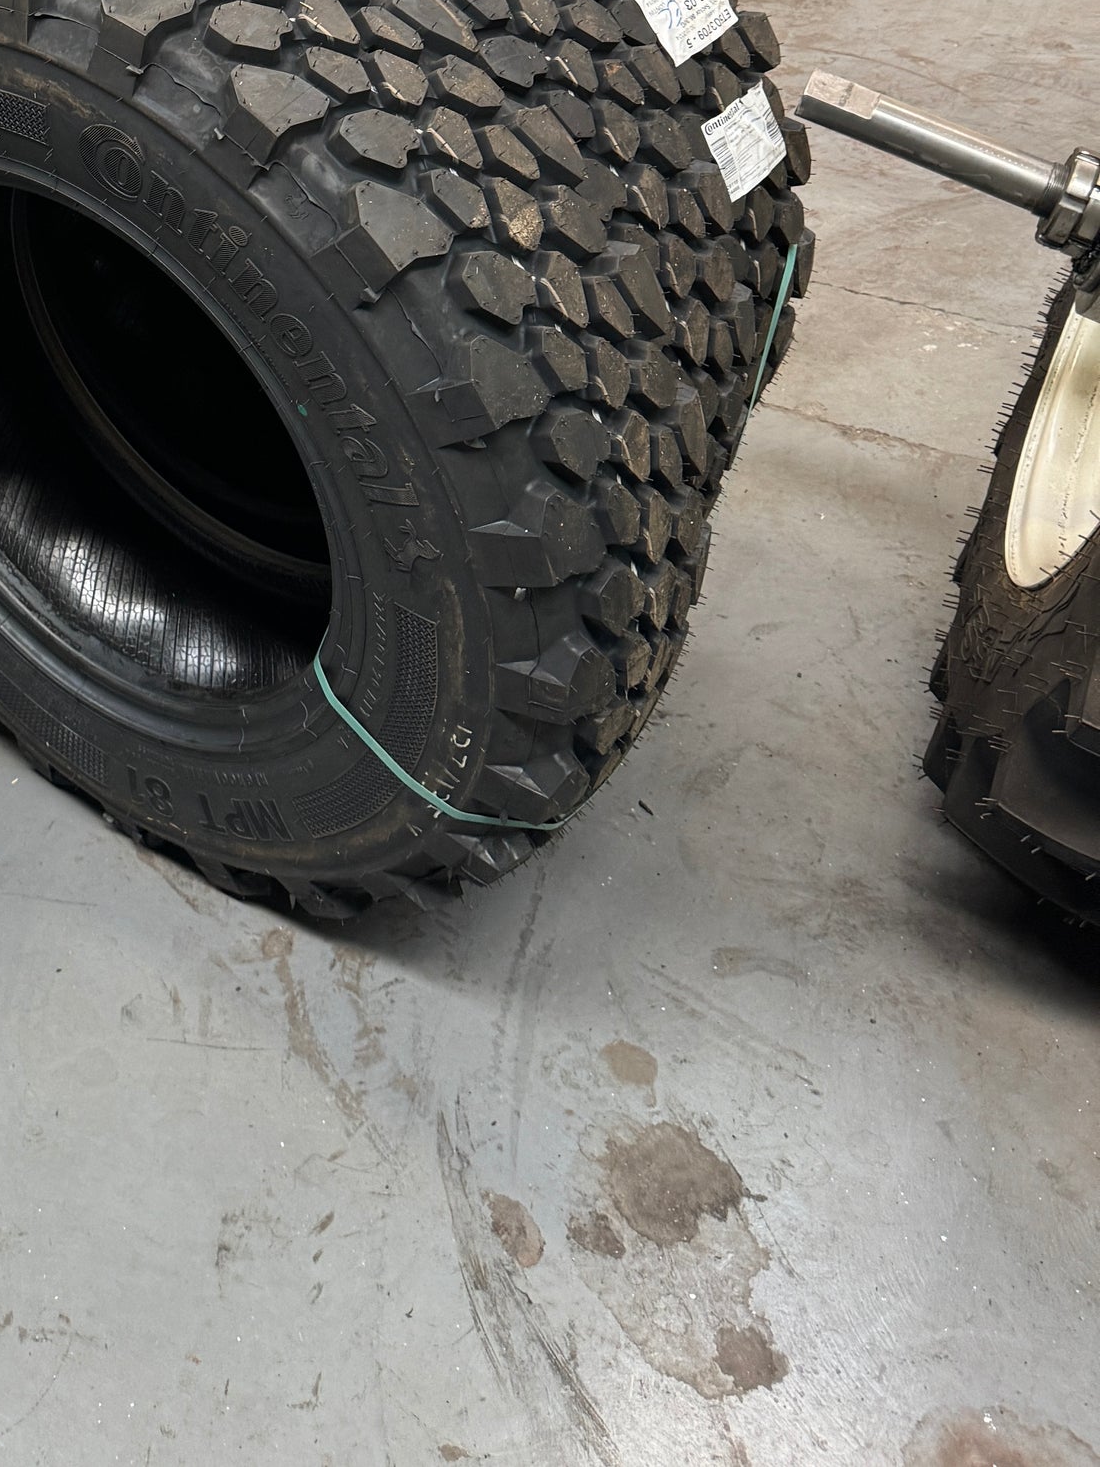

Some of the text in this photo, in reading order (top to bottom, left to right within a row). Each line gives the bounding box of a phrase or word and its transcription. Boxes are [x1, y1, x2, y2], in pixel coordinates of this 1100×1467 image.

[76, 123, 420, 507] Continental
[126, 763, 295, 842] MPT 81
